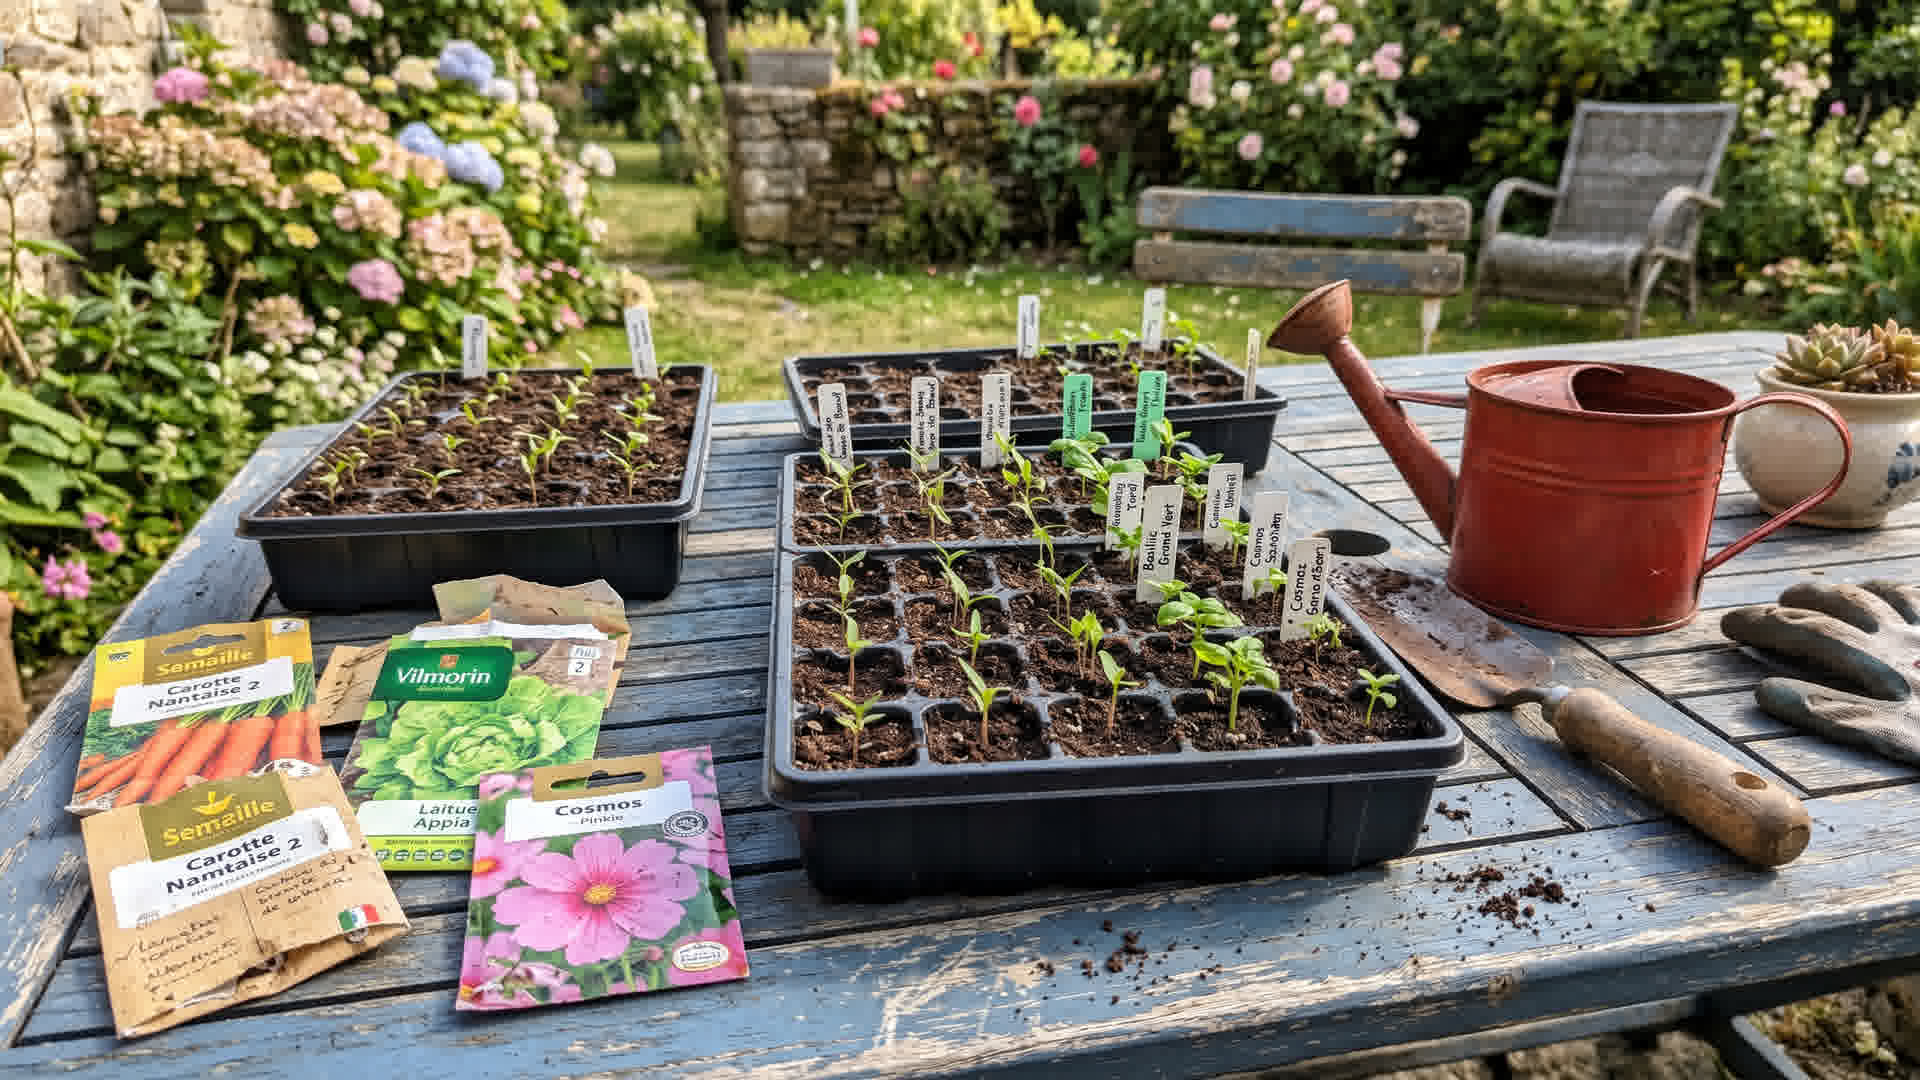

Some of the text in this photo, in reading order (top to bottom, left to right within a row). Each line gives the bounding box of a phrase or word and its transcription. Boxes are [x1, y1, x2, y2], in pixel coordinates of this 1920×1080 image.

[1161, 503, 1177, 527] Vert
[156, 648, 254, 676] Semaille
[575, 661, 585, 673] 2
[167, 674, 241, 696] Carotte
[397, 667, 491, 685] Vilmorin
[148, 686, 241, 711] Nantaise
[247, 680, 261, 692] 2
[419, 804, 478, 816] Laitue
[555, 799, 643, 816] Cosmos
[162, 799, 276, 846] Semaille
[413, 817, 470, 832] Appia
[580, 815, 625, 826] Pinkie
[186, 832, 274, 872] Carotte
[288, 837, 303, 851] 2
